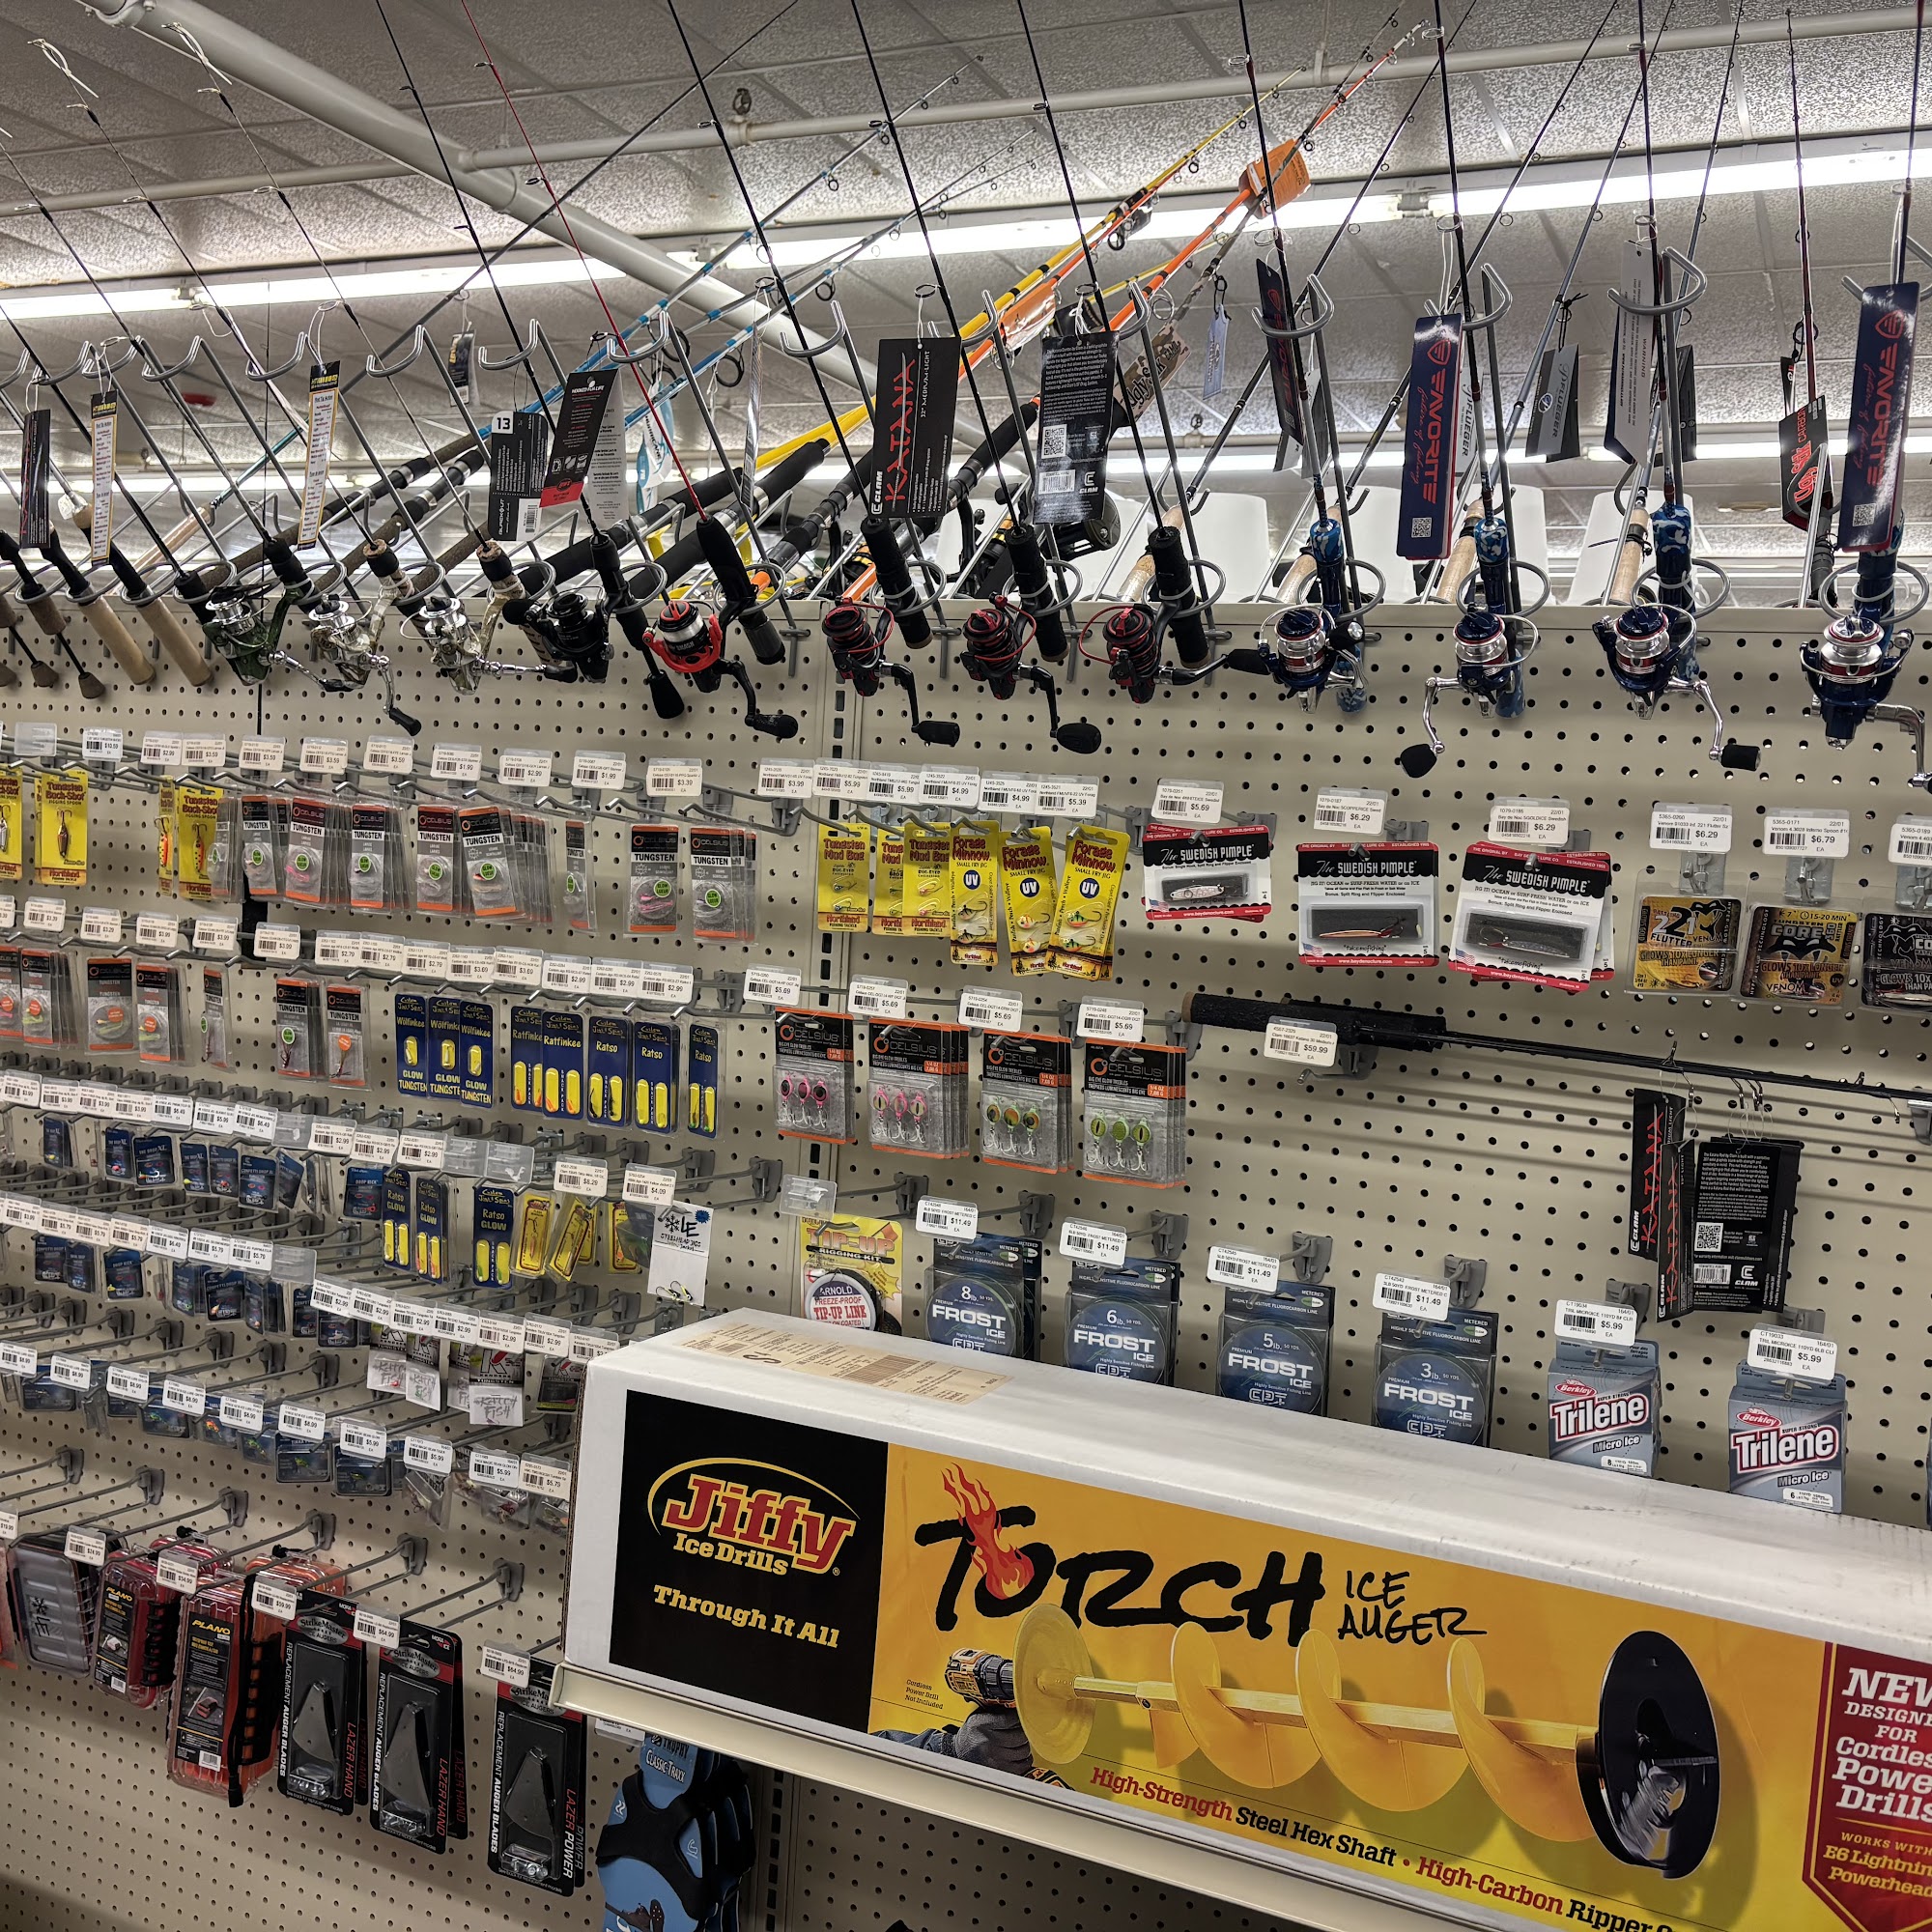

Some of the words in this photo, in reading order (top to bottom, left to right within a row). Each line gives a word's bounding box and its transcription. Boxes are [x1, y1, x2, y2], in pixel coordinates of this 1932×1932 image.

[1866, 343, 1896, 486] FAVORITE
[497, 417, 511, 430] 13
[885, 358, 916, 501] KATANA
[1422, 368, 1446, 504] FAVORITE
[874, 470, 883, 504] CLAM
[843, 780, 861, 789] $5.99
[952, 786, 969, 796] $4.99
[1068, 798, 1087, 807] $5.39
[1191, 803, 1210, 811] $5.69
[1350, 812, 1371, 822] $6.29
[292, 822, 323, 836] TUNGSTEN
[1533, 823, 1556, 832] $6.29
[1695, 829, 1719, 839] $6.29
[354, 830, 383, 840] TUNGSTEN
[466, 835, 500, 847] TUNGSTEN
[1810, 835, 1835, 845] $6.79
[823, 838, 866, 850] Tungsten
[952, 836, 986, 850] Forage
[1074, 839, 1114, 860] Forage
[634, 852, 675, 862] TUNGSTEN
[823, 849, 844, 861] Mud
[845, 850, 866, 862] Bug
[952, 847, 990, 862] Minnow
[1002, 843, 1040, 858] Forage
[1180, 847, 1218, 862] SWEDISH
[1220, 844, 1253, 859] PIMPLE
[693, 856, 729, 867] TUNGSTEN
[1002, 856, 1047, 872] Minnow
[1071, 853, 1116, 873] Minnow
[1338, 861, 1378, 874] SWEDISH
[1380, 861, 1415, 874] PIMPLE
[965, 873, 979, 886] UV
[1505, 869, 1549, 889] SWEDISH
[1550, 875, 1589, 895] PIMPLE
[1021, 881, 1037, 895] UV
[1081, 881, 1098, 895] UV
[826, 914, 861, 923] Northland
[1773, 919, 1824, 927] TUNGSTEN
[1771, 923, 1825, 939] CORE
[1650, 932, 1693, 947] FLUTTER
[881, 1000, 898, 1009] $5.69
[994, 1011, 1011, 1020] $5.69
[1114, 1021, 1133, 1031] $5.69
[543, 1036, 582, 1048] Ratfinkee
[794, 1029, 838, 1043] CELSIUS
[596, 1040, 618, 1053] Ratso
[641, 1046, 664, 1059] Ratso
[890, 1040, 937, 1055] CELSIUS
[1303, 1043, 1328, 1054] $59.99
[695, 1049, 712, 1063] Ratso
[1004, 1052, 1052, 1067] CELSIUS
[403, 1069, 423, 1080] GLOW
[1108, 1064, 1162, 1077] CELSIUS
[398, 1079, 427, 1092] TUNGSTEN
[466, 1079, 488, 1091] GLOW
[461, 1089, 492, 1105] TUNGSTEN
[1641, 1111, 1664, 1244] KATANA
[483, 1208, 505, 1220] Ratso
[481, 1220, 507, 1231] GLOW
[950, 1217, 972, 1227] $11.49
[1632, 1209, 1640, 1241] CLAM
[806, 1227, 895, 1256] TIP-UP
[1096, 1241, 1120, 1252] $11.49
[819, 1246, 862, 1260] RIGGING
[863, 1252, 882, 1263] KIT
[1247, 1267, 1271, 1278] $11.49
[819, 1286, 853, 1295] ARNOLD
[814, 1296, 863, 1305] FREEZE-PROOF
[1416, 1294, 1441, 1306] $11.49
[813, 1306, 843, 1321] TIP-UP
[844, 1304, 867, 1319] LINE
[932, 1305, 1007, 1329] FROST
[1463, 1318, 1489, 1326] METERED
[1601, 1320, 1624, 1331] $5.99
[986, 1328, 1006, 1339] ICE
[1074, 1329, 1155, 1351] FROST
[1760, 1330, 1784, 1340] CT19033
[1133, 1352, 1155, 1363] ICE
[1797, 1352, 1822, 1364] $5.99
[1228, 1352, 1314, 1379] FROST
[1290, 1378, 1312, 1389] ICE
[1560, 1384, 1593, 1397] Berkley
[1383, 1383, 1475, 1411] FROST
[1449, 1408, 1473, 1421] ICE
[1553, 1396, 1648, 1438] Trilene
[1742, 1413, 1777, 1427] Berkley
[1593, 1438, 1623, 1453] Micro
[1623, 1435, 1640, 1447] Ice
[1736, 1427, 1836, 1470] Trilene
[1777, 1473, 1810, 1488] Micro
[1810, 1470, 1830, 1483] Ice
[661, 1473, 857, 1575] Jiffy
[672, 1532, 714, 1558] Ice
[715, 1542, 789, 1577] Drills
[914, 1504, 1326, 1648] TORCH
[105, 1586, 133, 1603] PLANO
[1346, 1570, 1411, 1609] ICE
[653, 1584, 768, 1631] Through
[770, 1613, 796, 1637] It
[796, 1621, 840, 1649] All
[191, 1619, 231, 1635] PLANO
[299, 1617, 347, 1640] StrikeMaster
[1337, 1606, 1489, 1646] AUGER
[316, 1633, 338, 1643] AUGERS
[393, 1648, 439, 1672] StrikeMaster
[906, 1679, 933, 1691] Cordless
[905, 1687, 926, 1698] Power
[924, 1691, 940, 1701] Drill
[376, 1672, 385, 1739] REPLACEMENT
[904, 1694, 917, 1703] Not
[916, 1697, 945, 1711] Included
[281, 1704, 290, 1739] AUGER
[345, 1722, 356, 1760] LAZER
[1874, 1724, 1918, 1745] FOR
[495, 1711, 505, 1778] REPLACEMENT
[374, 1738, 383, 1774] AUGER
[645, 1749, 686, 1783] CLASSIC-TRAXX
[343, 1761, 355, 1799] HAND
[438, 1757, 448, 1797] LAZER
[493, 1777, 502, 1812] AUGER
[436, 1797, 446, 1837] HAND
[565, 1788, 577, 1832] LAZER
[490, 1812, 499, 1854] BLADES
[1090, 1766, 1234, 1822] High-Strength
[1236, 1805, 1290, 1838] Steel
[1292, 1820, 1333, 1850] Hex
[1335, 1833, 1398, 1867] Shaft
[1414, 1855, 1564, 1917] High-Carbon
[1841, 1832, 1891, 1849] WORKS
[562, 1831, 575, 1879] POWER
[1823, 1844, 1851, 1861] E6
